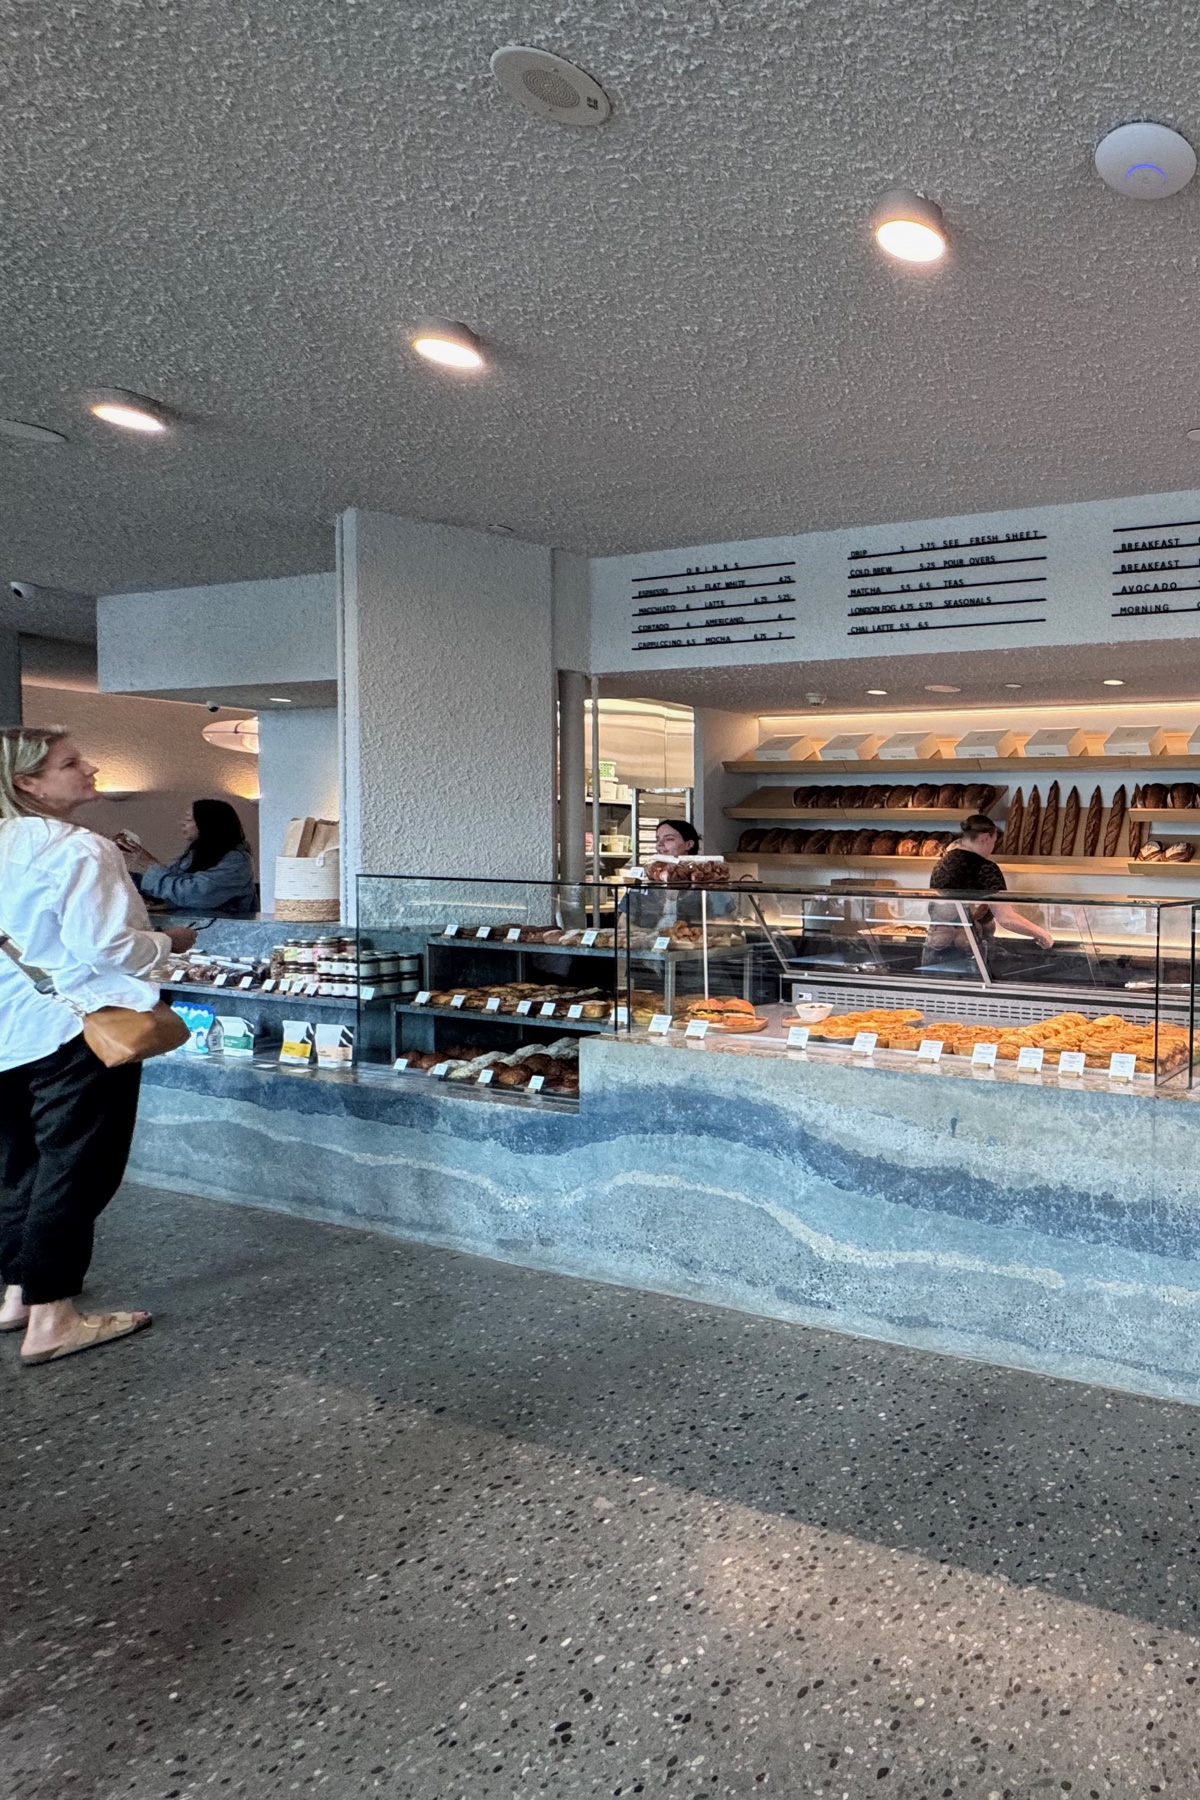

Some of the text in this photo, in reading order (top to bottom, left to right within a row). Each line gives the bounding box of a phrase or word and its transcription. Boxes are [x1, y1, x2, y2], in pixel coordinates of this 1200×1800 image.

[942, 530, 1039, 548] SEE FRESH SHEET
[1121, 538, 1180, 551] BREAKFAST
[850, 550, 868, 558] DRIP
[943, 555, 996, 568] POUR OVERS
[1120, 560, 1180, 573] BREAKFAST
[686, 562, 739, 574] DRINKS
[850, 568, 870, 577] COLD
[873, 566, 893, 574] BREW
[725, 580, 746, 588] WHITE
[943, 579, 964, 587] TEAS
[1121, 581, 1178, 594] AVOCADO
[638, 588, 669, 597] ESPRESSO
[850, 586, 882, 596] MATCHA
[704, 600, 726, 608] LATTE
[943, 596, 992, 607] SEASONALS
[638, 605, 676, 614] MACCHIATO
[851, 605, 880, 615] LONDON
[881, 603, 897, 612] FOG
[1119, 603, 1170, 615] MORNING
[705, 616, 744, 626] AMERICANO
[638, 623, 669, 631] CORTADO
[851, 625, 869, 634] CHAI
[872, 623, 895, 632] LATTE
[638, 639, 682, 649] CAPPUCCINO
[705, 635, 731, 643] MOCHA
